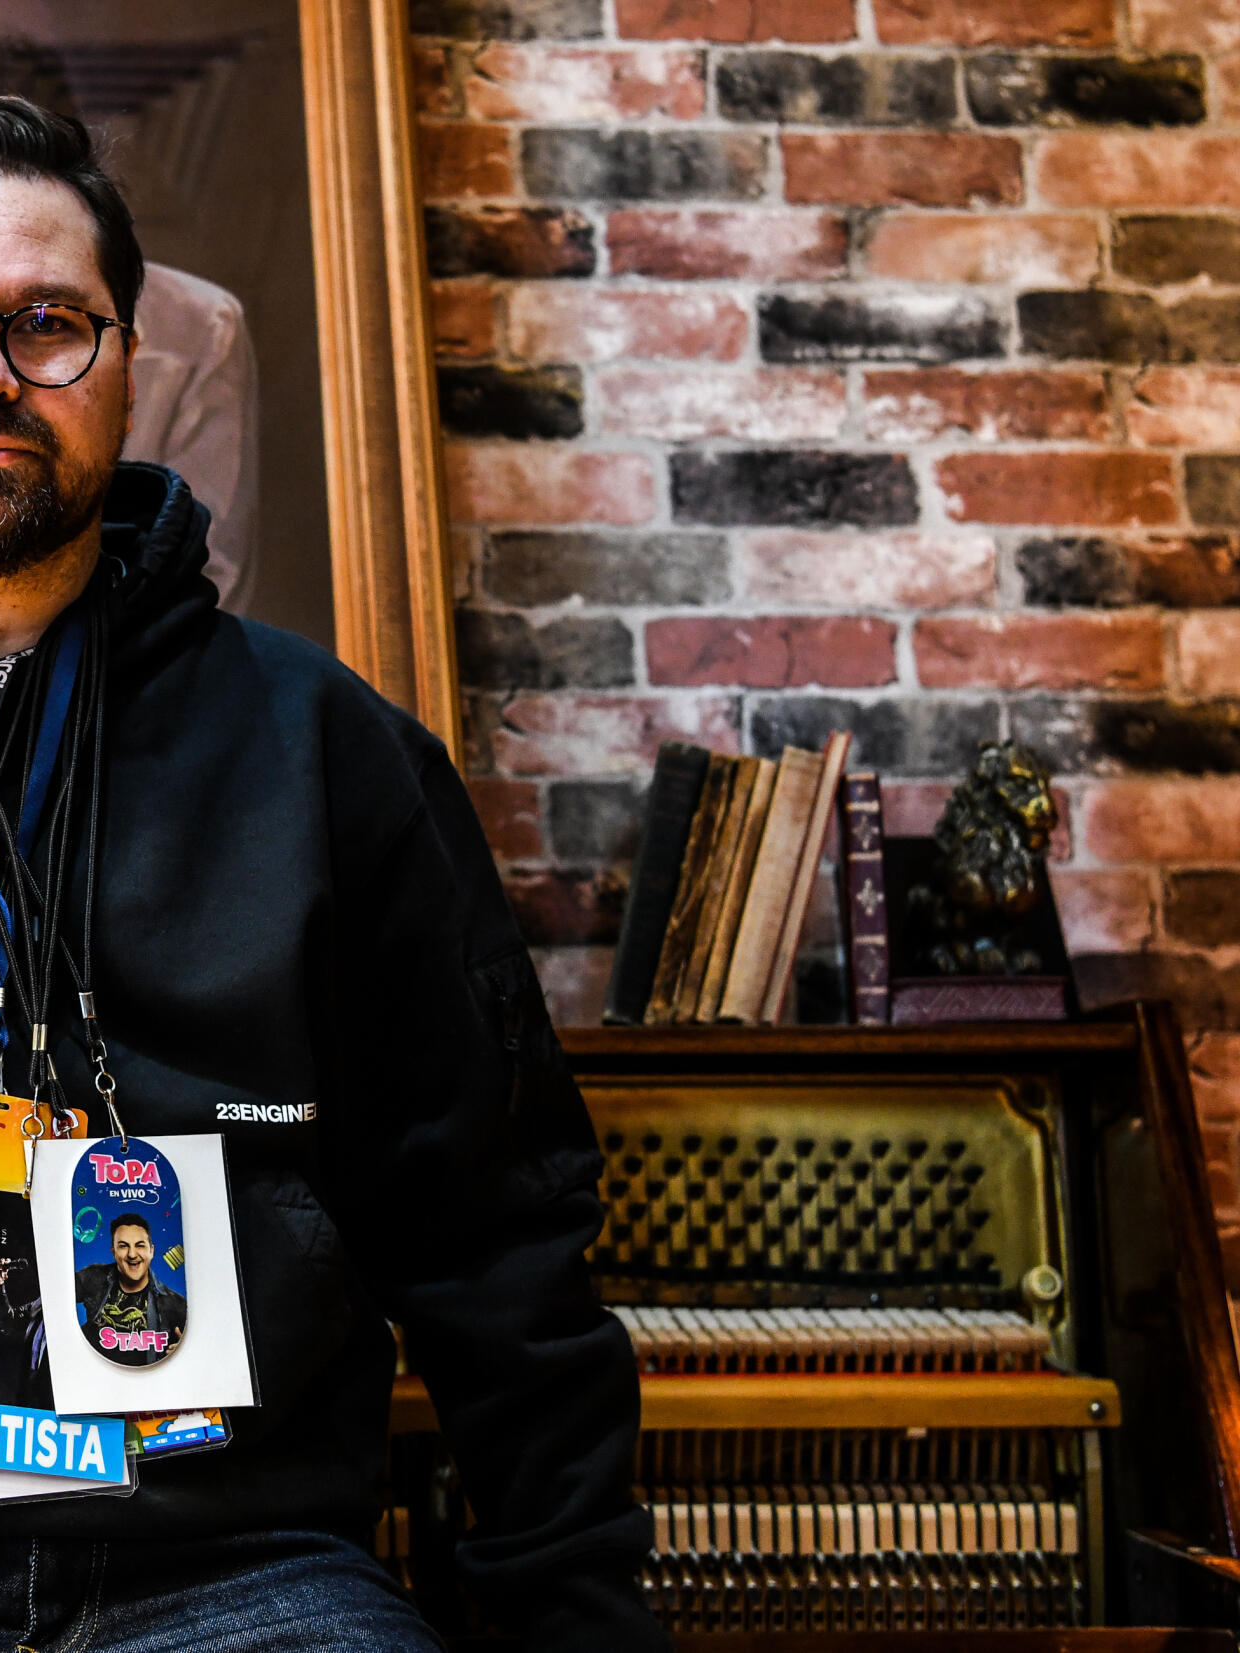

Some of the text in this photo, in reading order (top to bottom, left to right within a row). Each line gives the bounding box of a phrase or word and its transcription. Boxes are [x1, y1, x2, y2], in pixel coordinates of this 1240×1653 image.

[216, 1101, 316, 1122] 23ENGINE
[89, 1153, 161, 1187] TOPA
[109, 1188, 146, 1199] EN VIVO
[99, 1327, 169, 1352] STAFF
